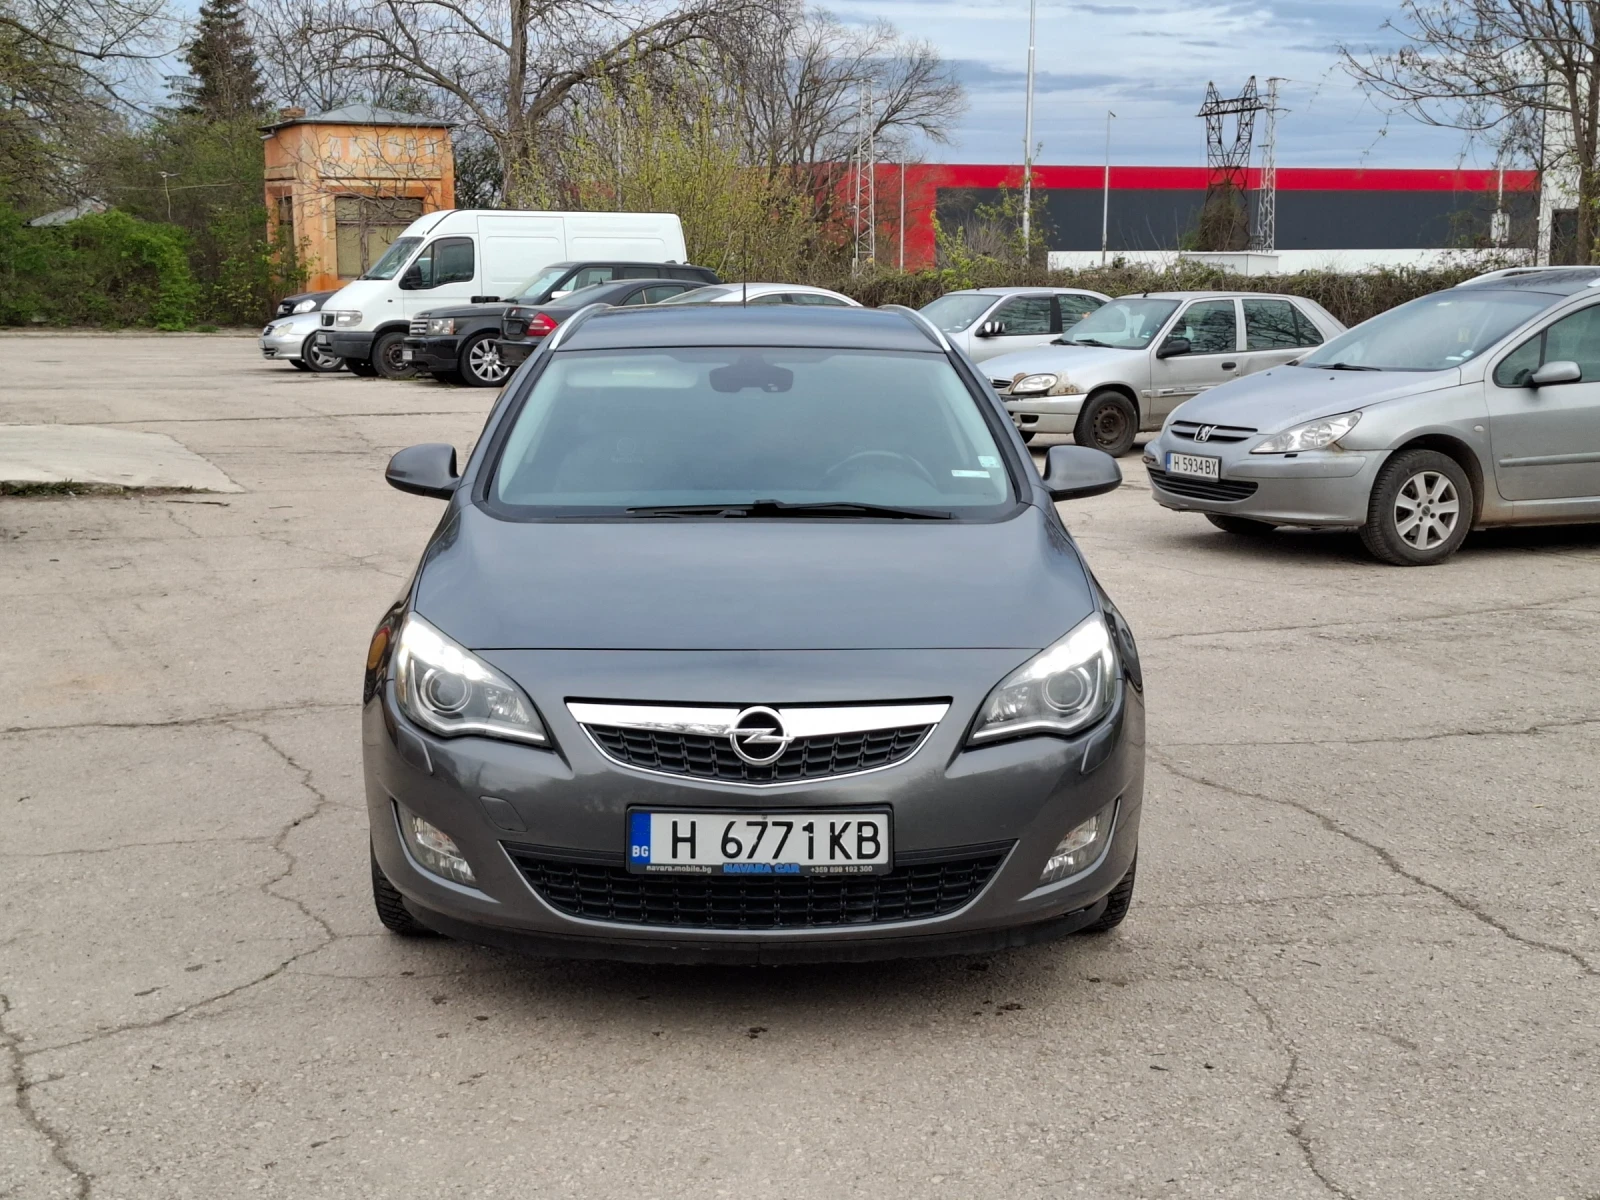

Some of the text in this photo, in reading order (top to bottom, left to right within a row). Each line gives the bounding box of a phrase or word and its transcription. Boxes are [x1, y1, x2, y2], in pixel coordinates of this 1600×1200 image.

[1174, 456, 1180, 471] H
[672, 820, 696, 859] H
[632, 845, 649, 858] BG
[646, 865, 712, 874] navara.mobile.bg
[723, 863, 800, 873] NAVARA CAR
